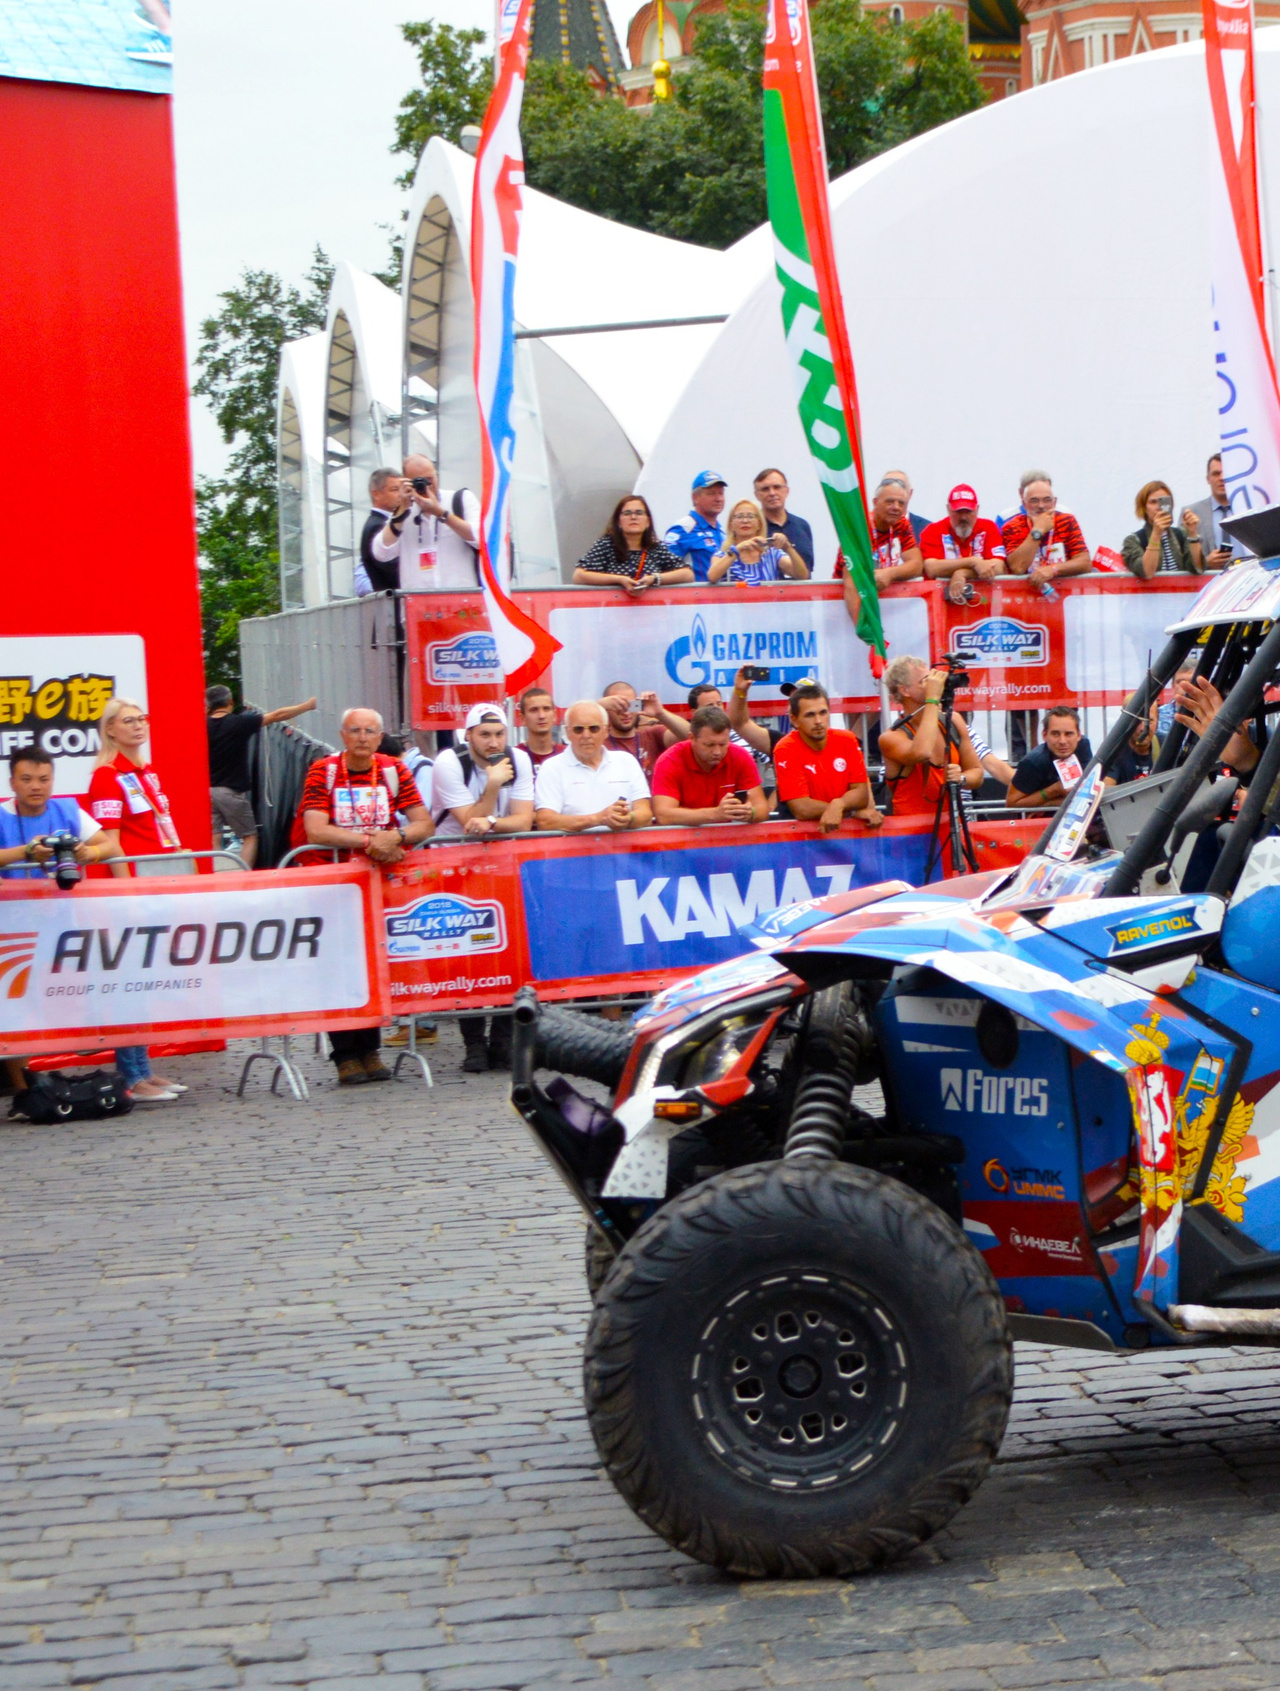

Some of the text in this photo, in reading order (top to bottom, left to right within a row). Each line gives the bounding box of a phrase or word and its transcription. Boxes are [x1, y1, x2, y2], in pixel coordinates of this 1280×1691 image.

[712, 631, 818, 661] GAZPROM
[960, 634, 1037, 646] SILK WAY
[438, 651, 479, 661] SILK
[716, 667, 817, 685] AIA
[391, 912, 490, 934] SILK WAY
[423, 929, 463, 938] RALLY
[1116, 915, 1193, 944] RAVENOL
[51, 916, 324, 974] AVTODOR
[46, 977, 203, 998] GROUP OF COMPANIES
[390, 974, 512, 996] ilkwayrally.com
[966, 1069, 1048, 1116] Fores
[1010, 1166, 1062, 1184] УГМК
[1014, 1181, 1064, 1199] UMMC
